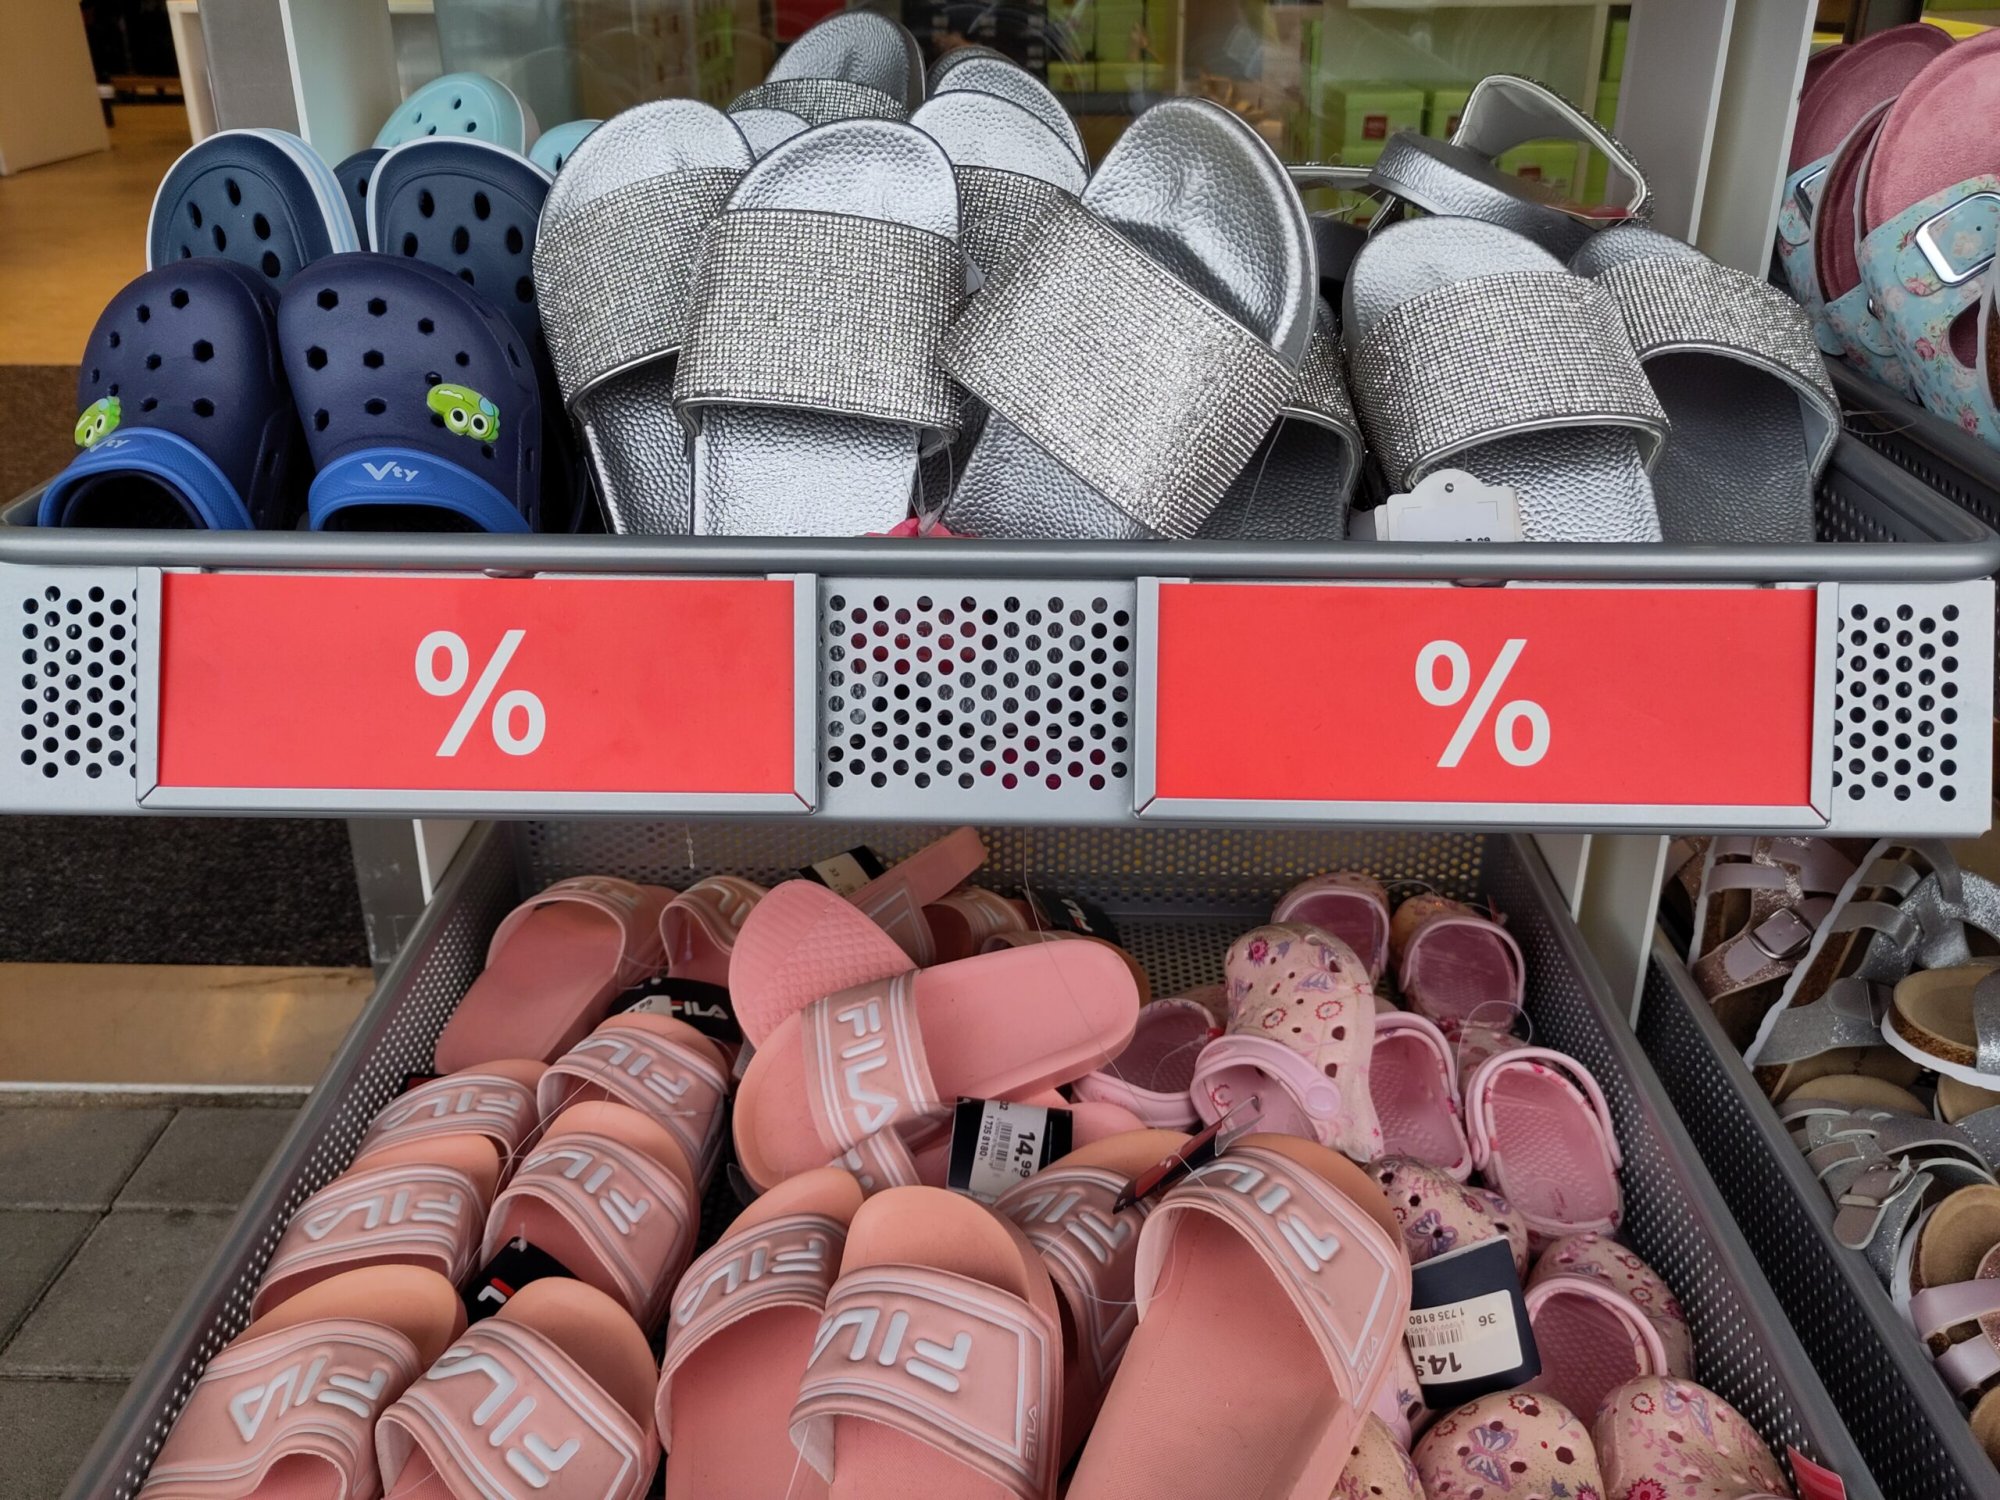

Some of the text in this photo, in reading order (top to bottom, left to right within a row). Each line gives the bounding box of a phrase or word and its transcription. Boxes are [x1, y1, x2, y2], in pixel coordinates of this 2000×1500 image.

[361, 461, 420, 483] Vty
[414, 628, 547, 757] %
[1414, 638, 1551, 768] %
[837, 1001, 898, 1135] FILA
[305, 1190, 462, 1241] FILA
[676, 1239, 824, 1327] FILA
[1409, 1312, 1435, 1326] 8180
[1438, 1308, 1457, 1321] 735
[1478, 1312, 1497, 1327] 36
[1414, 1351, 1462, 1378] 14.9
[228, 1354, 389, 1442] FILA
[1024, 1404, 1038, 1461] FILA
